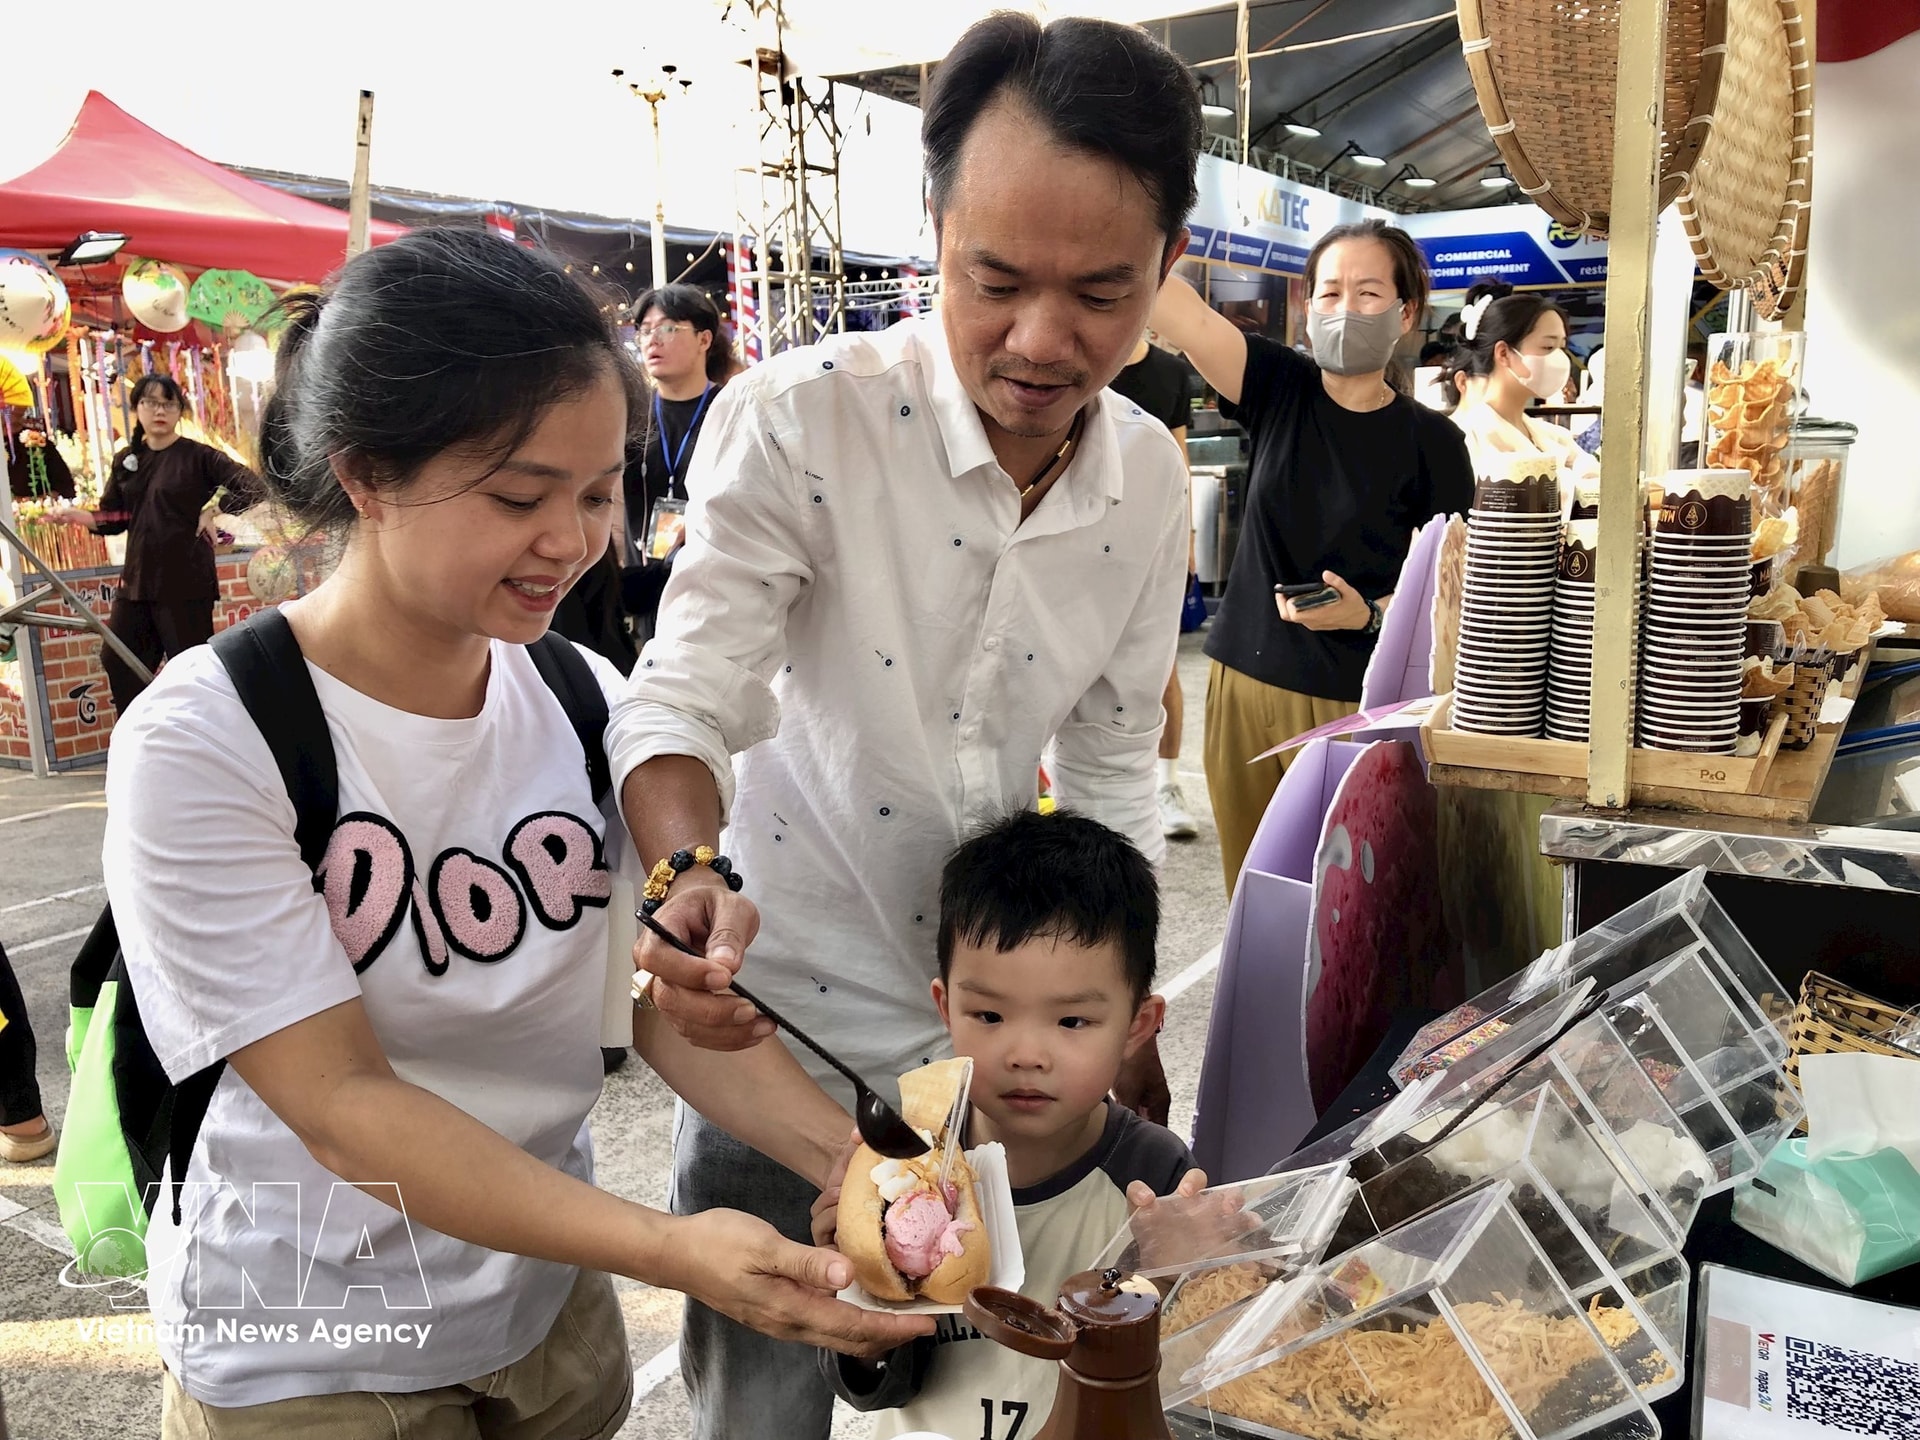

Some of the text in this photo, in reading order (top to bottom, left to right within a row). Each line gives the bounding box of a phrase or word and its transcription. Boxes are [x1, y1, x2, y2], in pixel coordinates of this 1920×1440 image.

[1258, 186, 1310, 232] KATEC
[1435, 249, 1513, 263] COMMERCIAL
[1466, 263, 1530, 276] EQUIPMENT
[311, 811, 611, 977] DIOR
[980, 1398, 1028, 1440] 17
